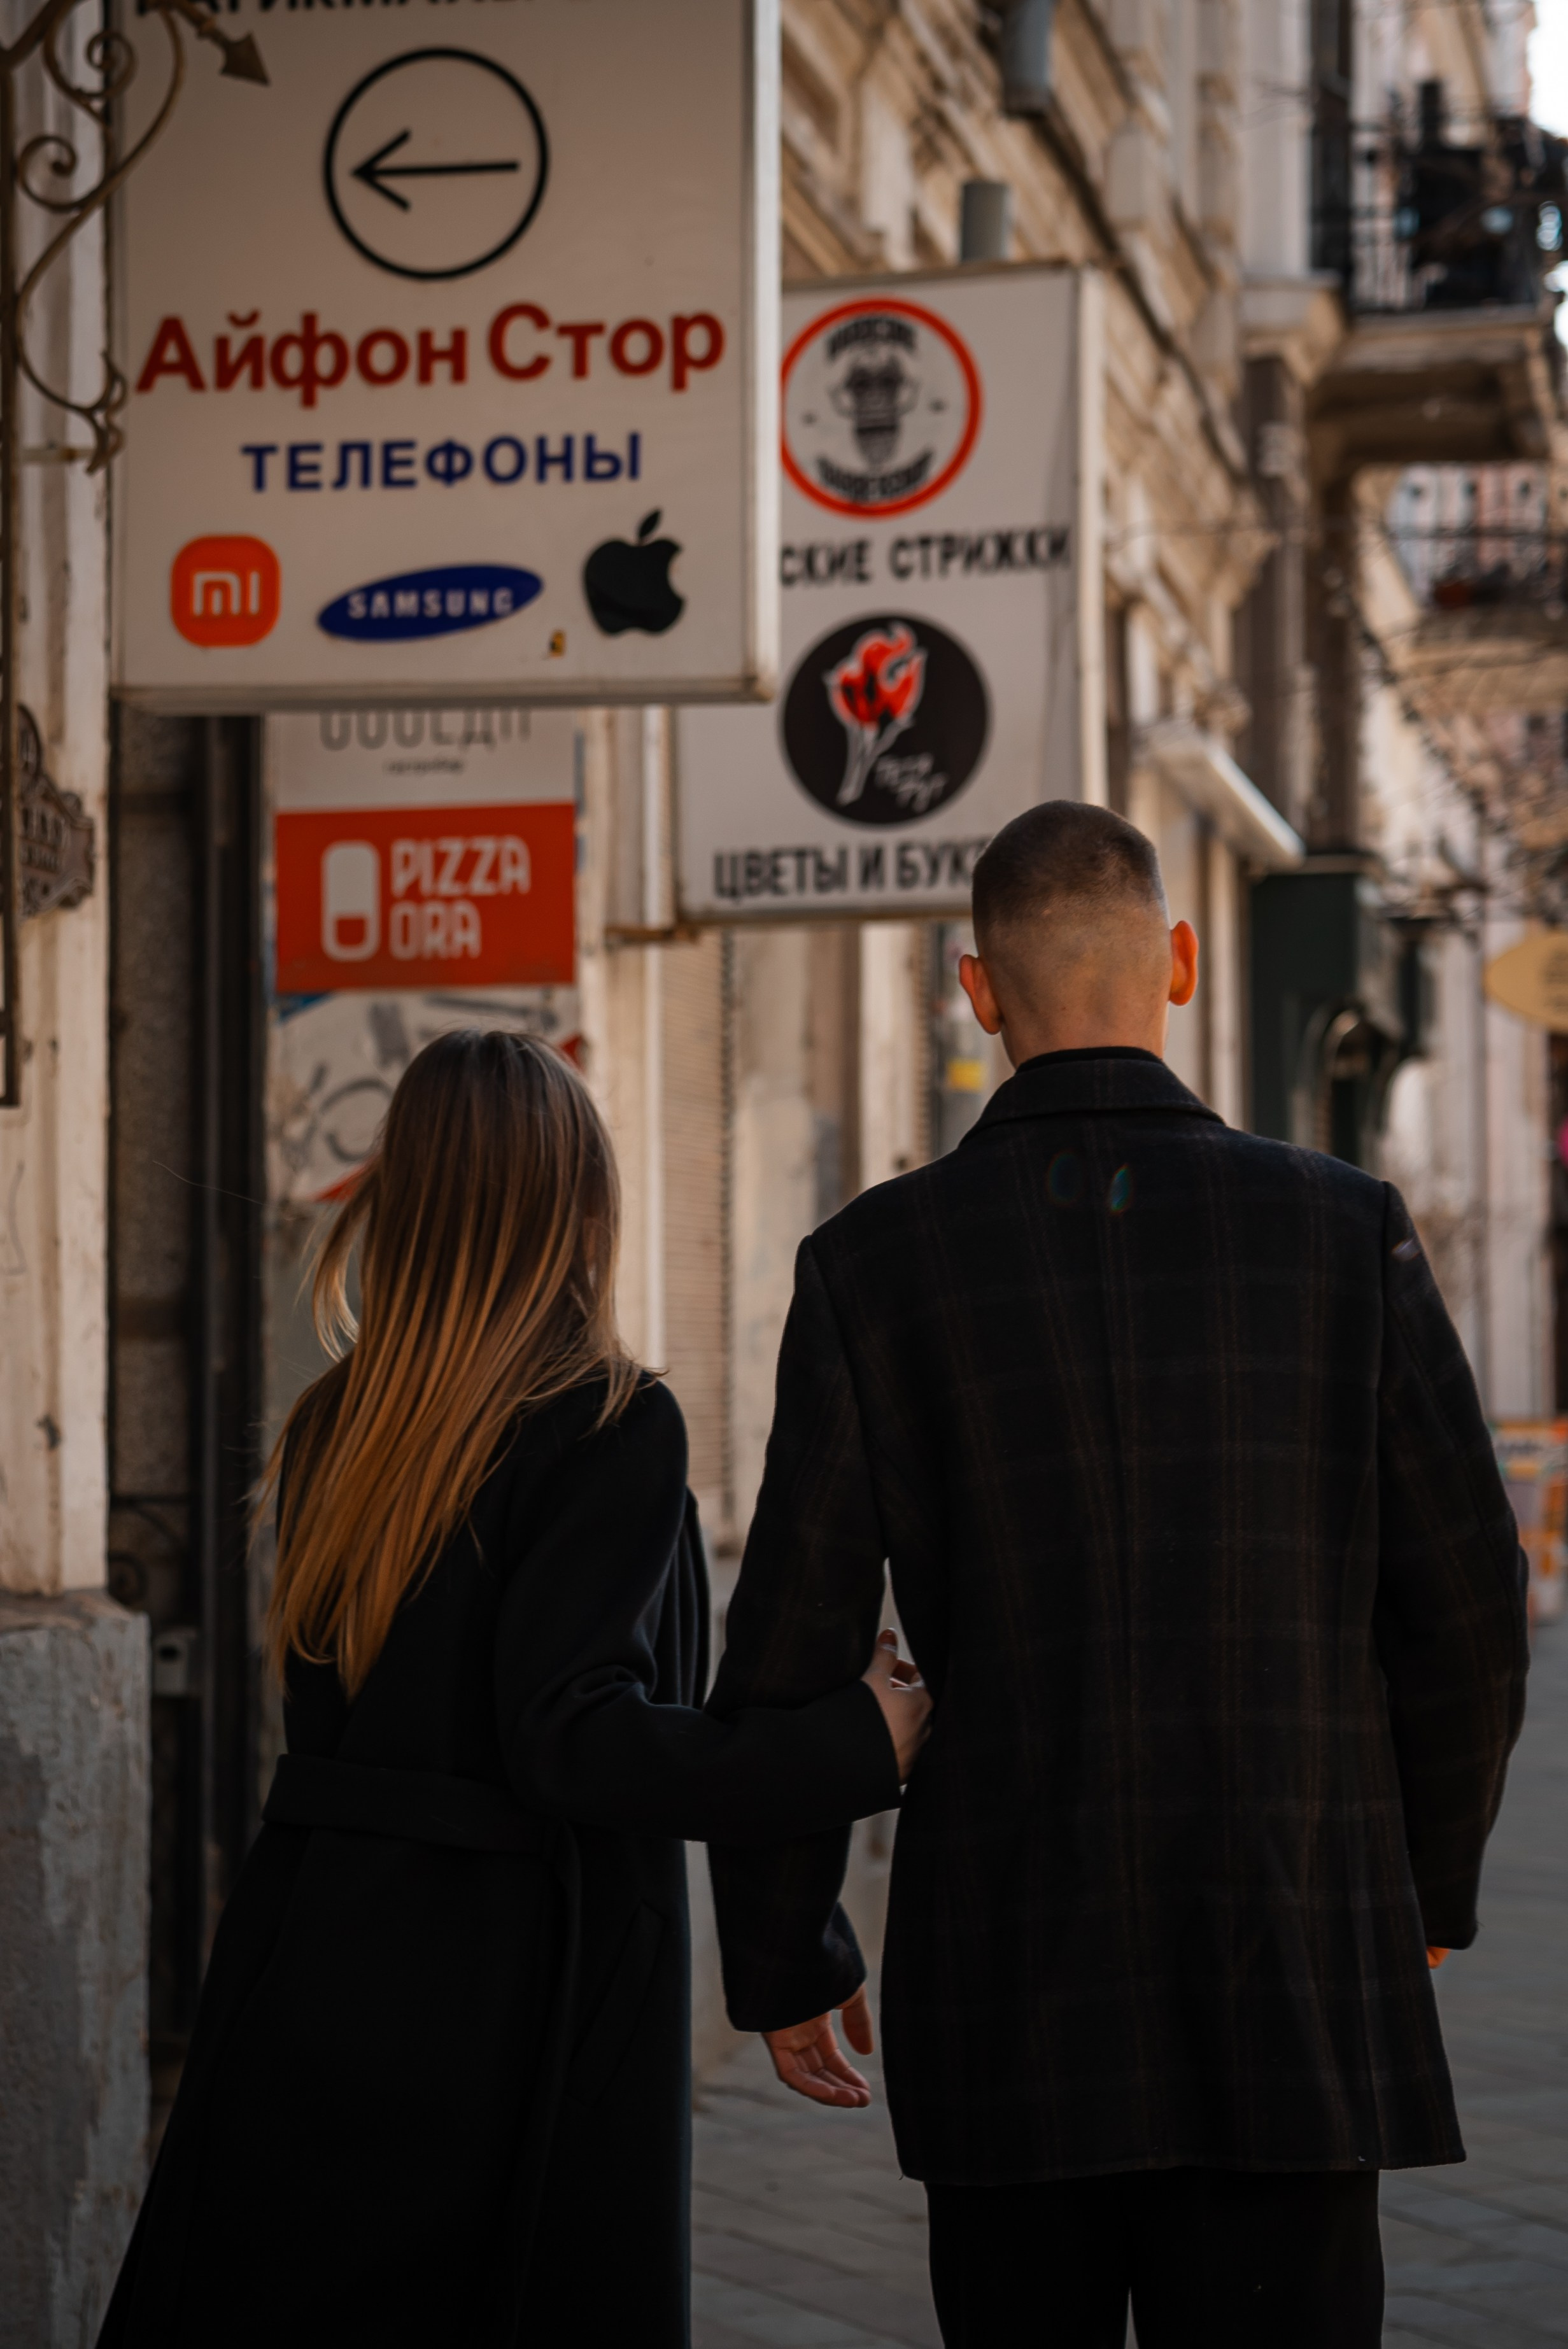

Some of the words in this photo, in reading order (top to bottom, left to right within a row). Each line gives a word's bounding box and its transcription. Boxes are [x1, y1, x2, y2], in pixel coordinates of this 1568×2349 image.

[135, 307, 469, 409] Айфон
[487, 301, 725, 393] Стор
[241, 431, 642, 493] ТЕЛЕФОНЫ
[891, 526, 1073, 580] СТРИЖКИ
[347, 587, 515, 618] SAMSUNG
[390, 834, 532, 898] PIZZA
[713, 843, 848, 901] ЦВЕТЫ
[859, 843, 885, 889] И
[896, 837, 991, 889] БУК
[389, 899, 482, 960] ORA
